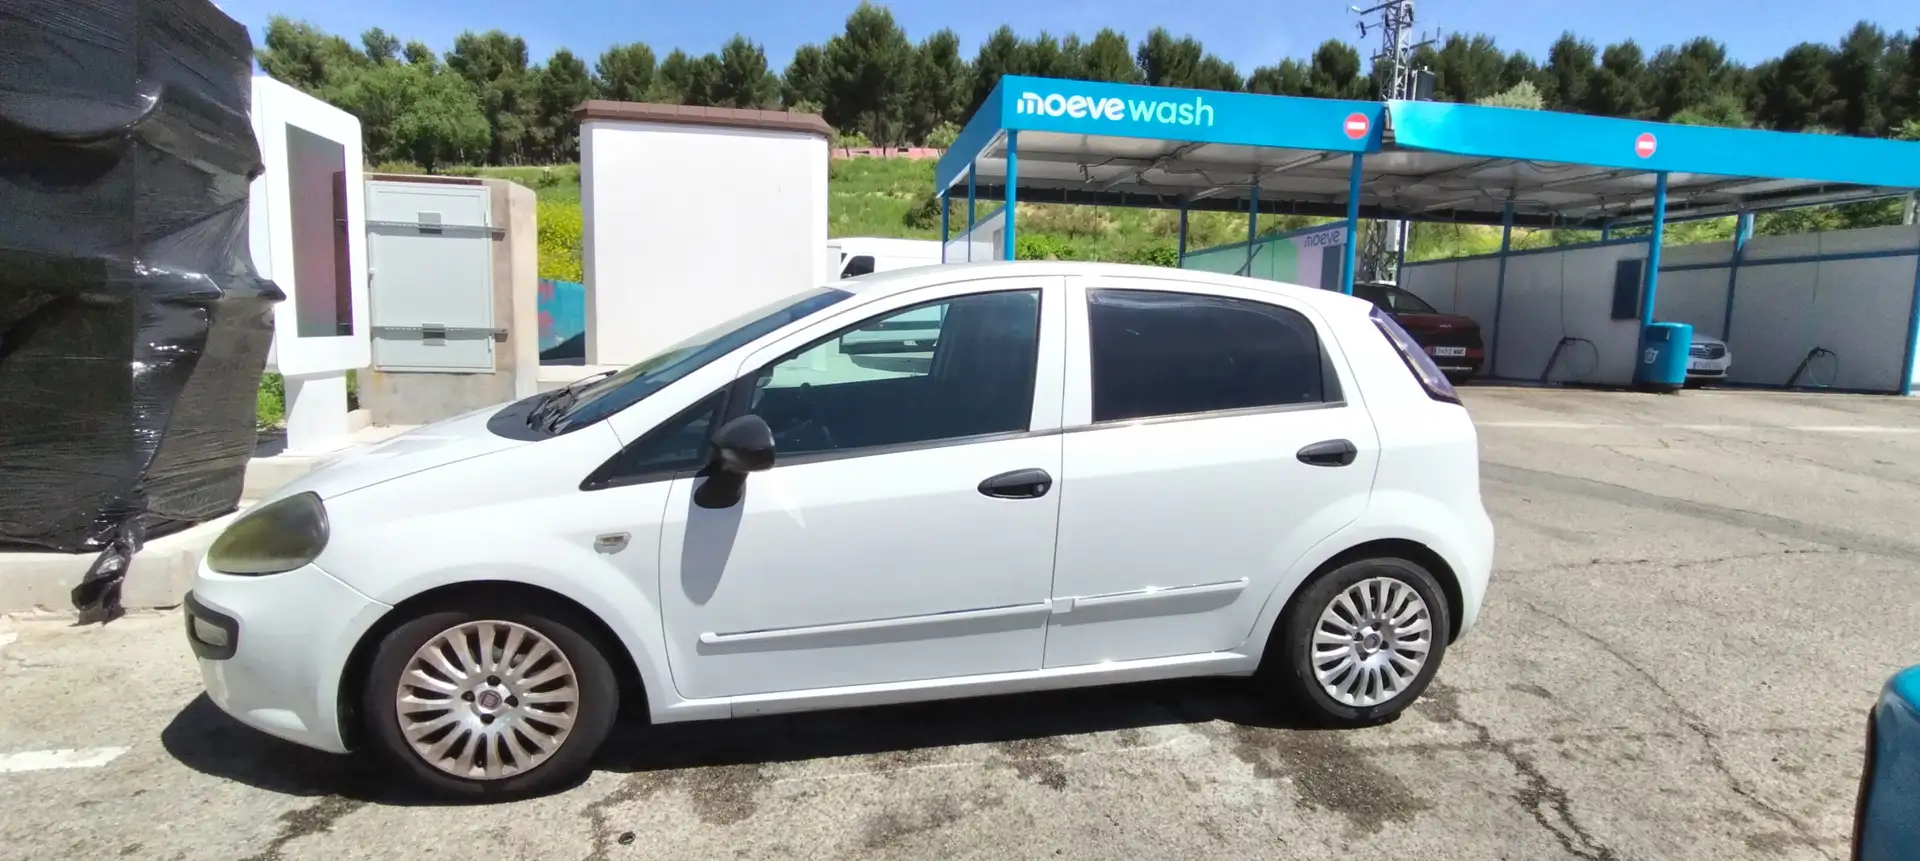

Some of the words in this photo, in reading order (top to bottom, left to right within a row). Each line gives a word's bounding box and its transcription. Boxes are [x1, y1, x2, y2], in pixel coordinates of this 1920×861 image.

[1017, 91, 1125, 121] moeve
[1128, 96, 1214, 127] wash
[1304, 230, 1340, 248] moeve
